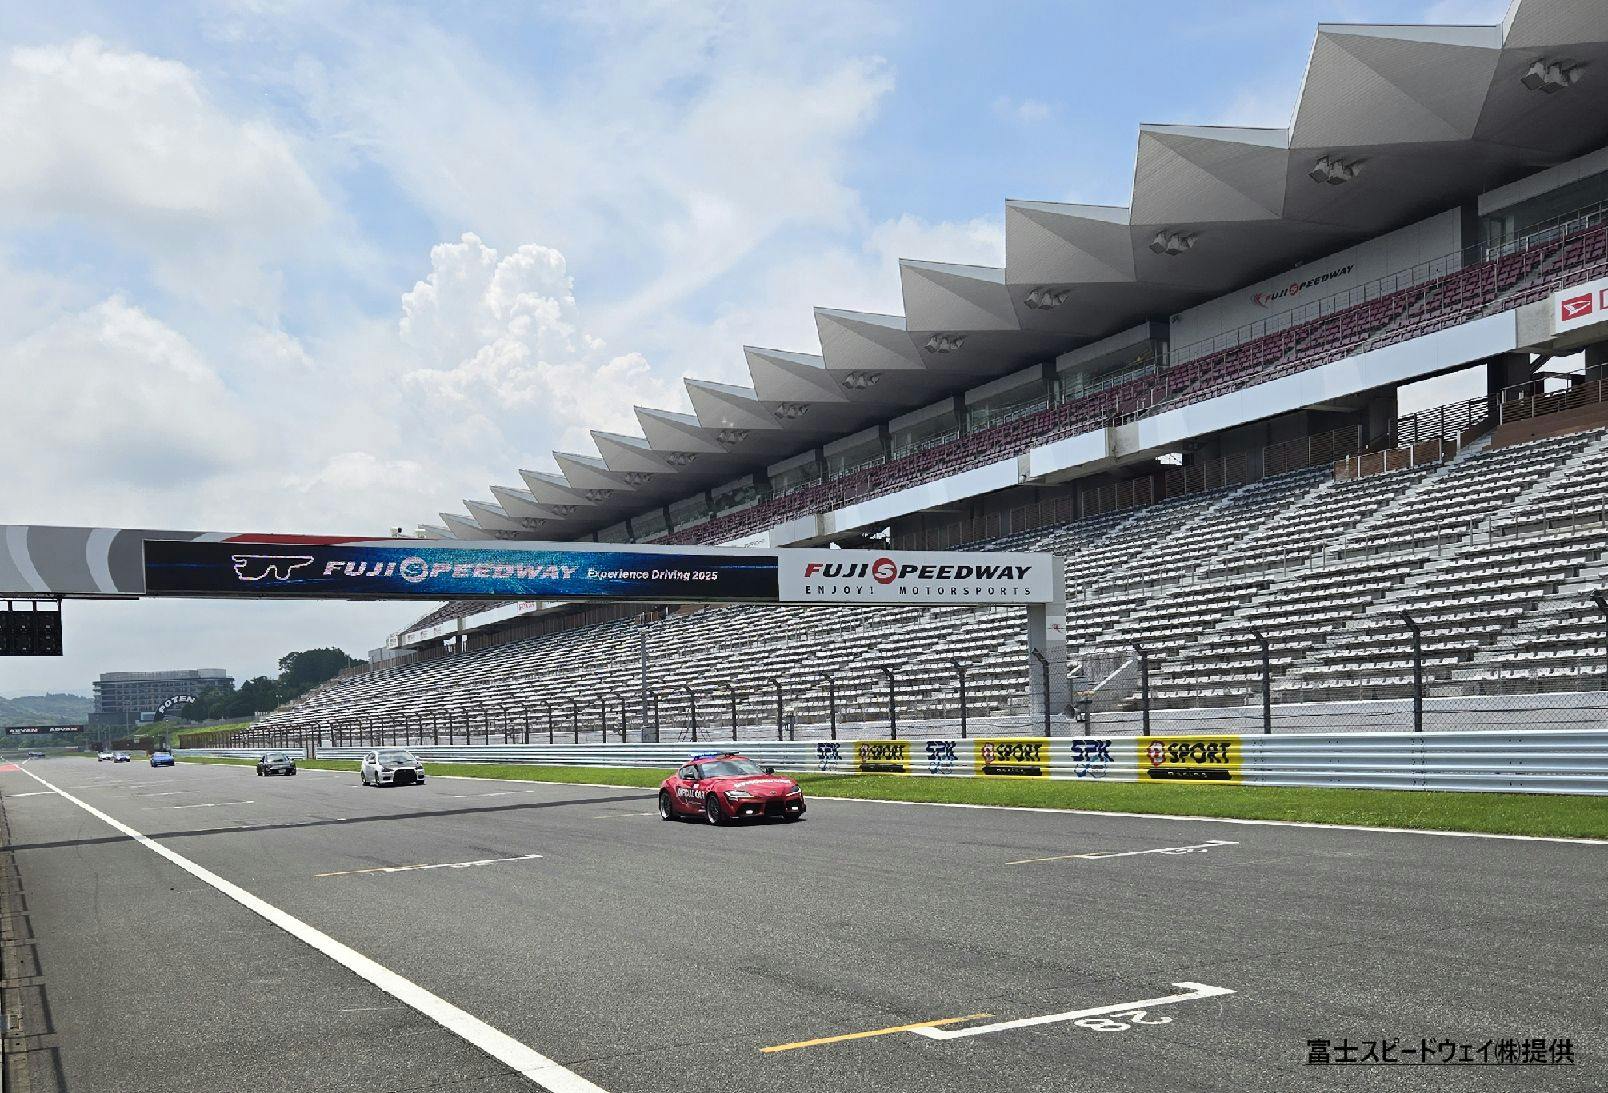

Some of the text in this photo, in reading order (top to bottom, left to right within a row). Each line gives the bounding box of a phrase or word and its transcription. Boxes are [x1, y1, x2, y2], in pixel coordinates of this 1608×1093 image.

[323, 555, 579, 583] FUJI SPEEDWAY
[587, 567, 718, 581] Experience Driving 2025
[804, 557, 1032, 585] FUJI SPEEDWAY
[805, 585, 1031, 596] ENJOY! MOTORSPORTS
